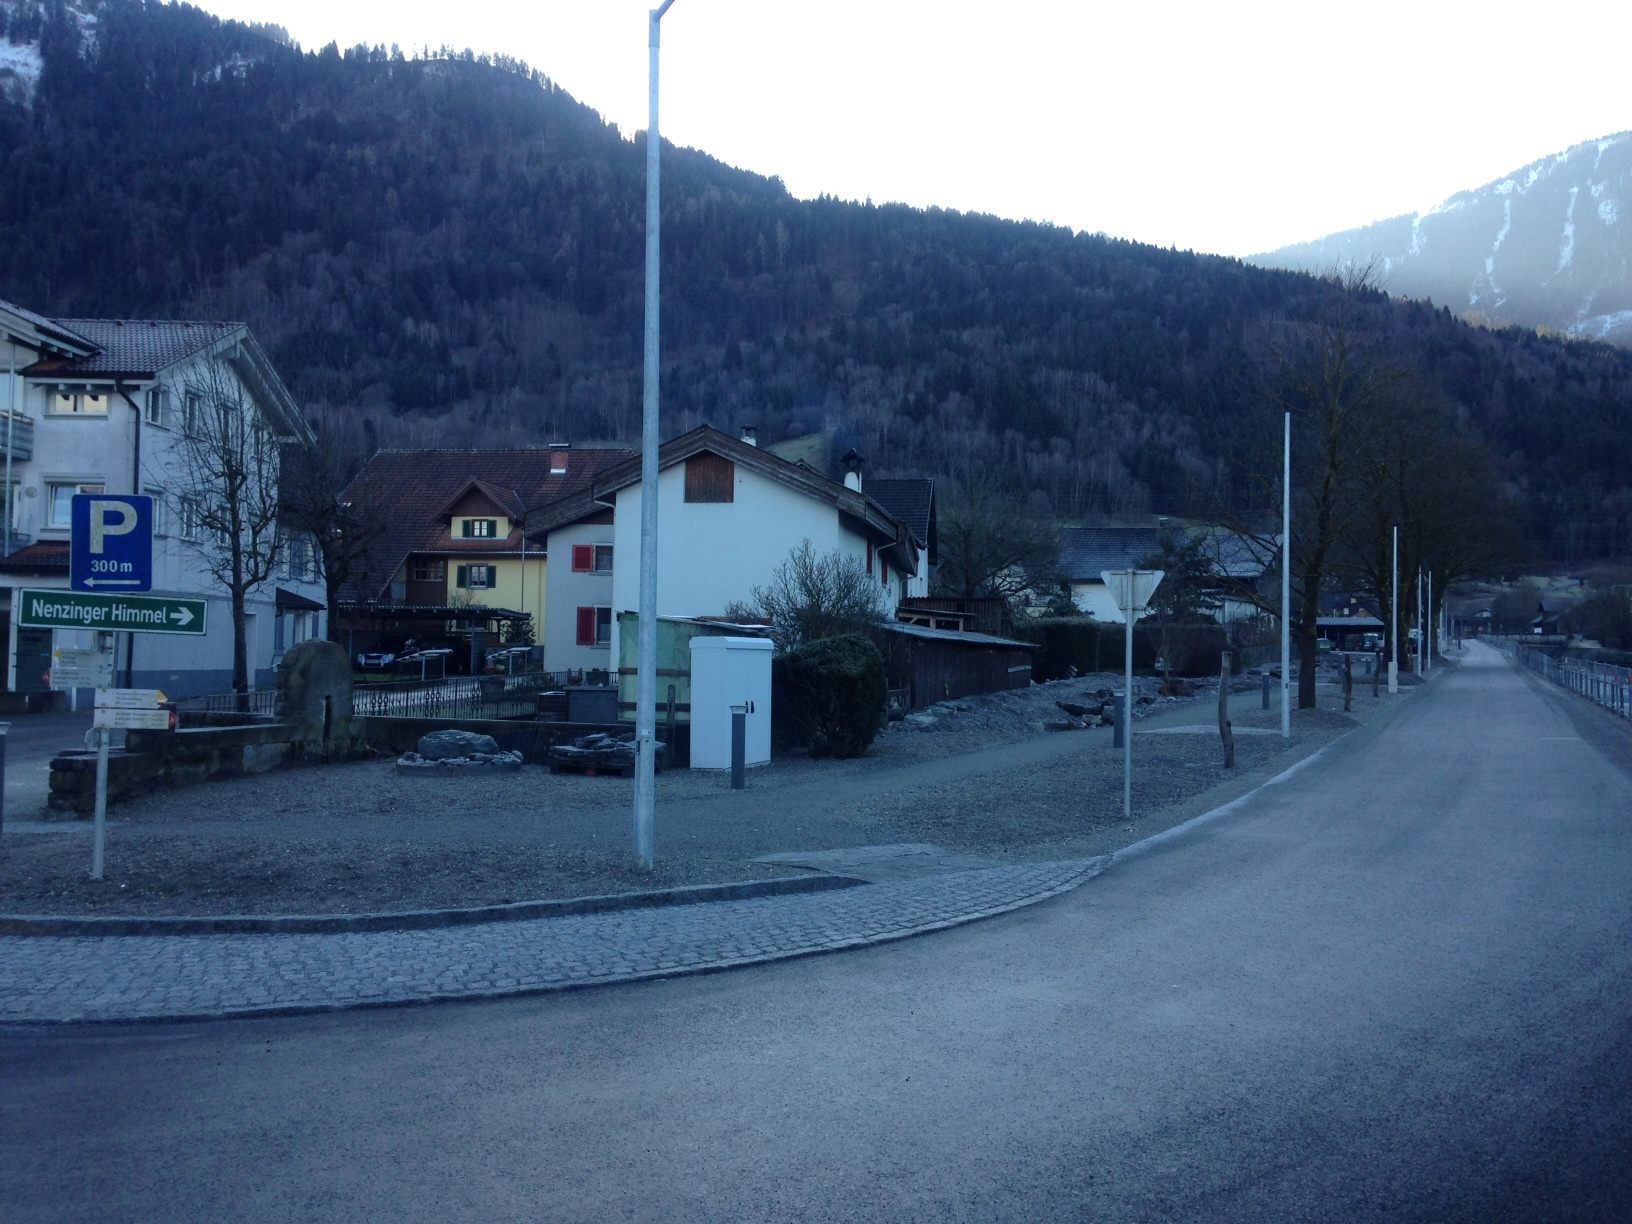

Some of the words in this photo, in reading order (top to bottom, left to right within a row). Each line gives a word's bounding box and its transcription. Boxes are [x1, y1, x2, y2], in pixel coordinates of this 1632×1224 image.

[90, 500, 138, 554] P
[91, 560, 118, 573] 300
[120, 563, 133, 573] m
[32, 598, 109, 624] Nenzinger
[112, 603, 167, 624] Himmel
